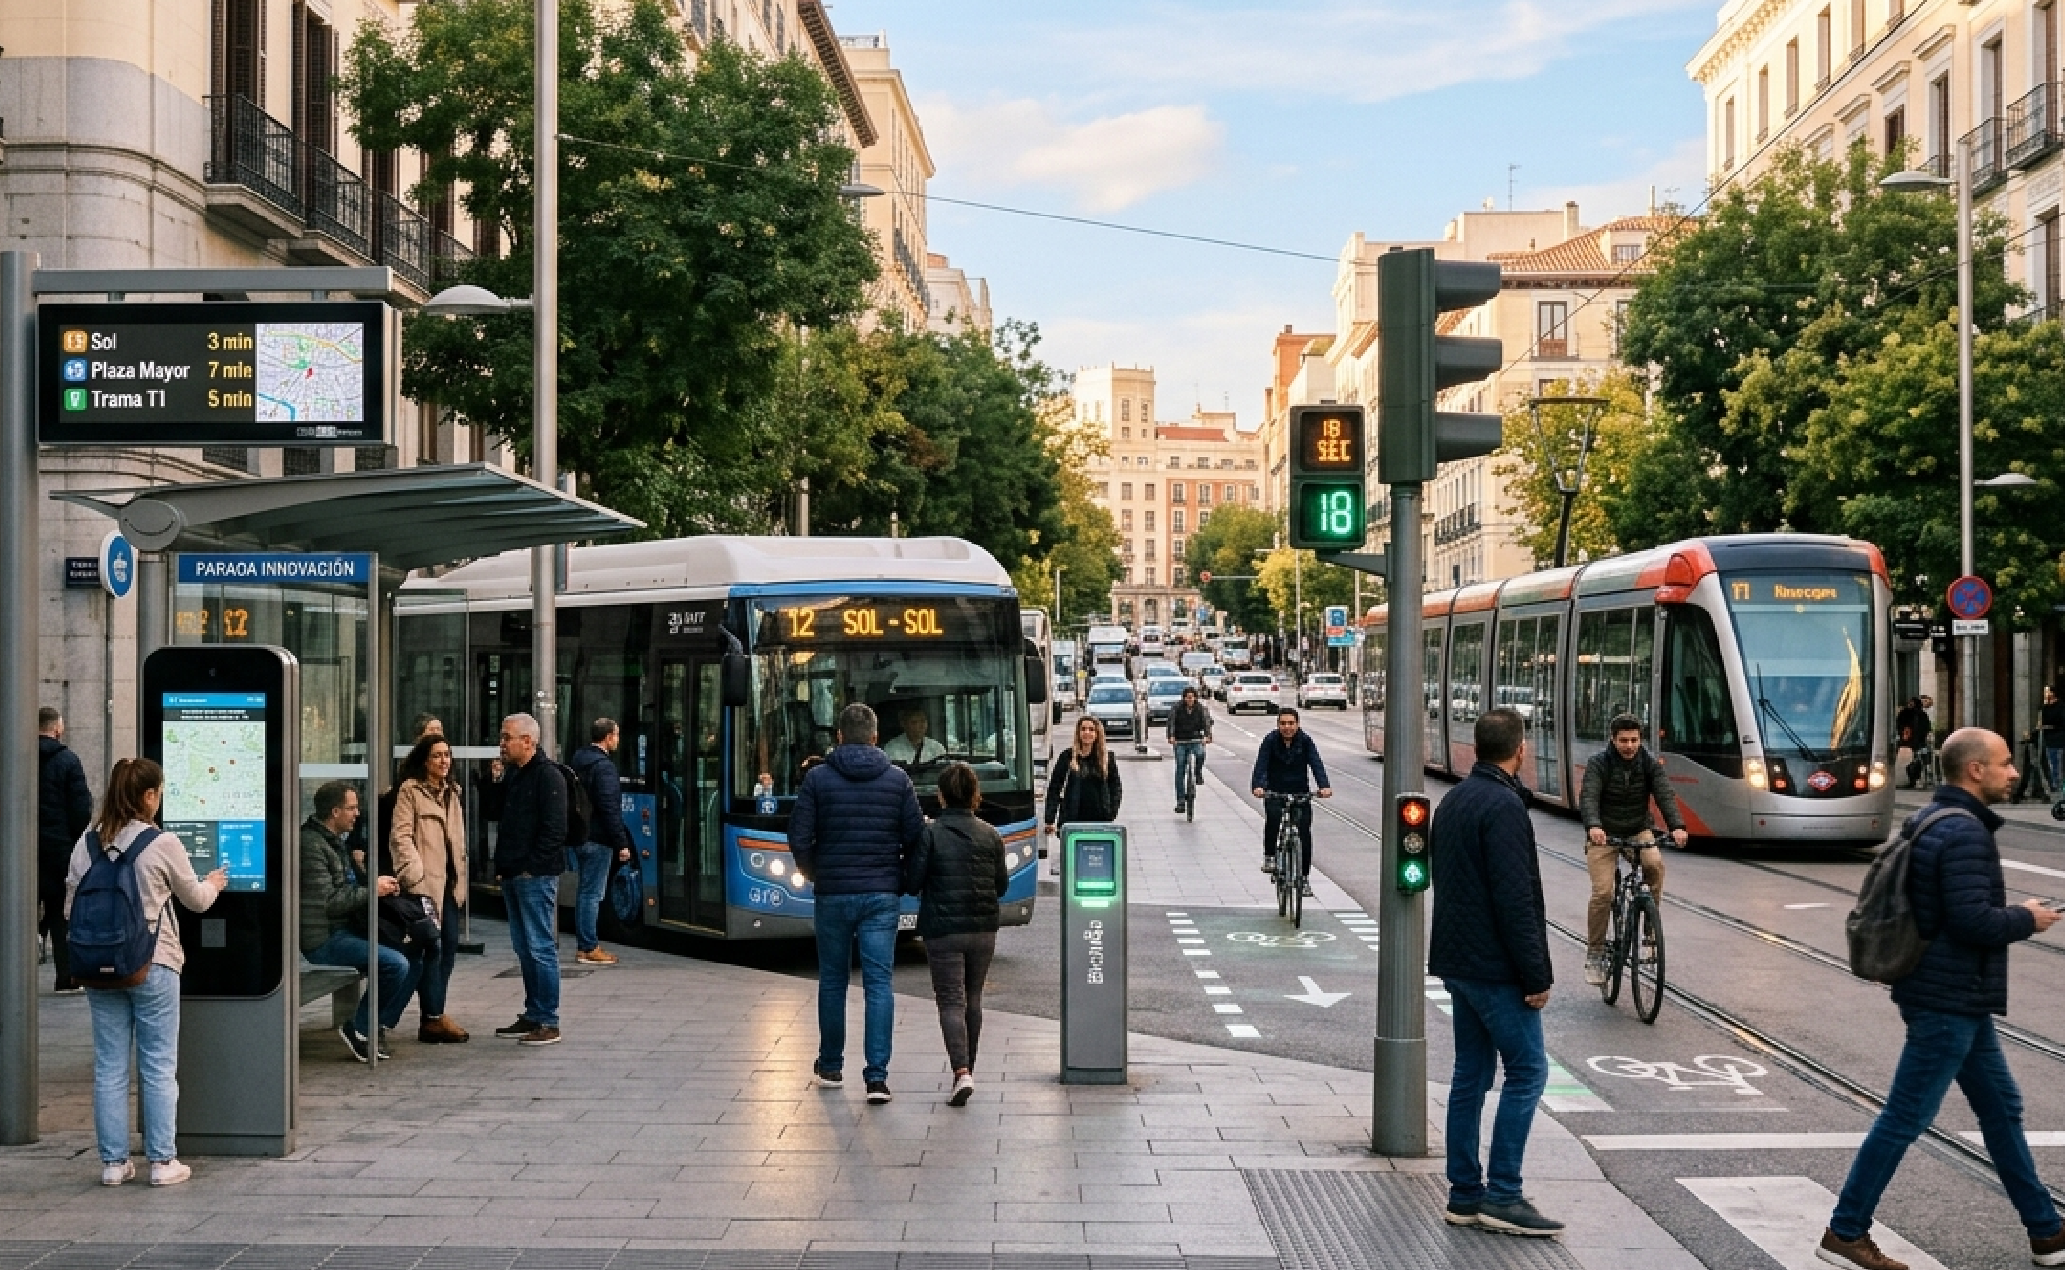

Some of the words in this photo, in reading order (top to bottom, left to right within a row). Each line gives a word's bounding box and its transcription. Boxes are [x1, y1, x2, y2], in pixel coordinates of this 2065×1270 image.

[91, 332, 117, 350] Sol
[207, 331, 220, 350] 3
[223, 332, 253, 350] min
[91, 361, 136, 379] Plaza
[139, 361, 191, 383] Mayor
[208, 361, 220, 379] 7
[91, 390, 143, 408] Trama
[208, 389, 220, 408] 5
[1320, 490, 1352, 535] 18
[261, 557, 355, 577] INNOVACIÓN
[788, 607, 815, 637] 12
[843, 608, 884, 636] SOL
[904, 608, 944, 636] SOL
